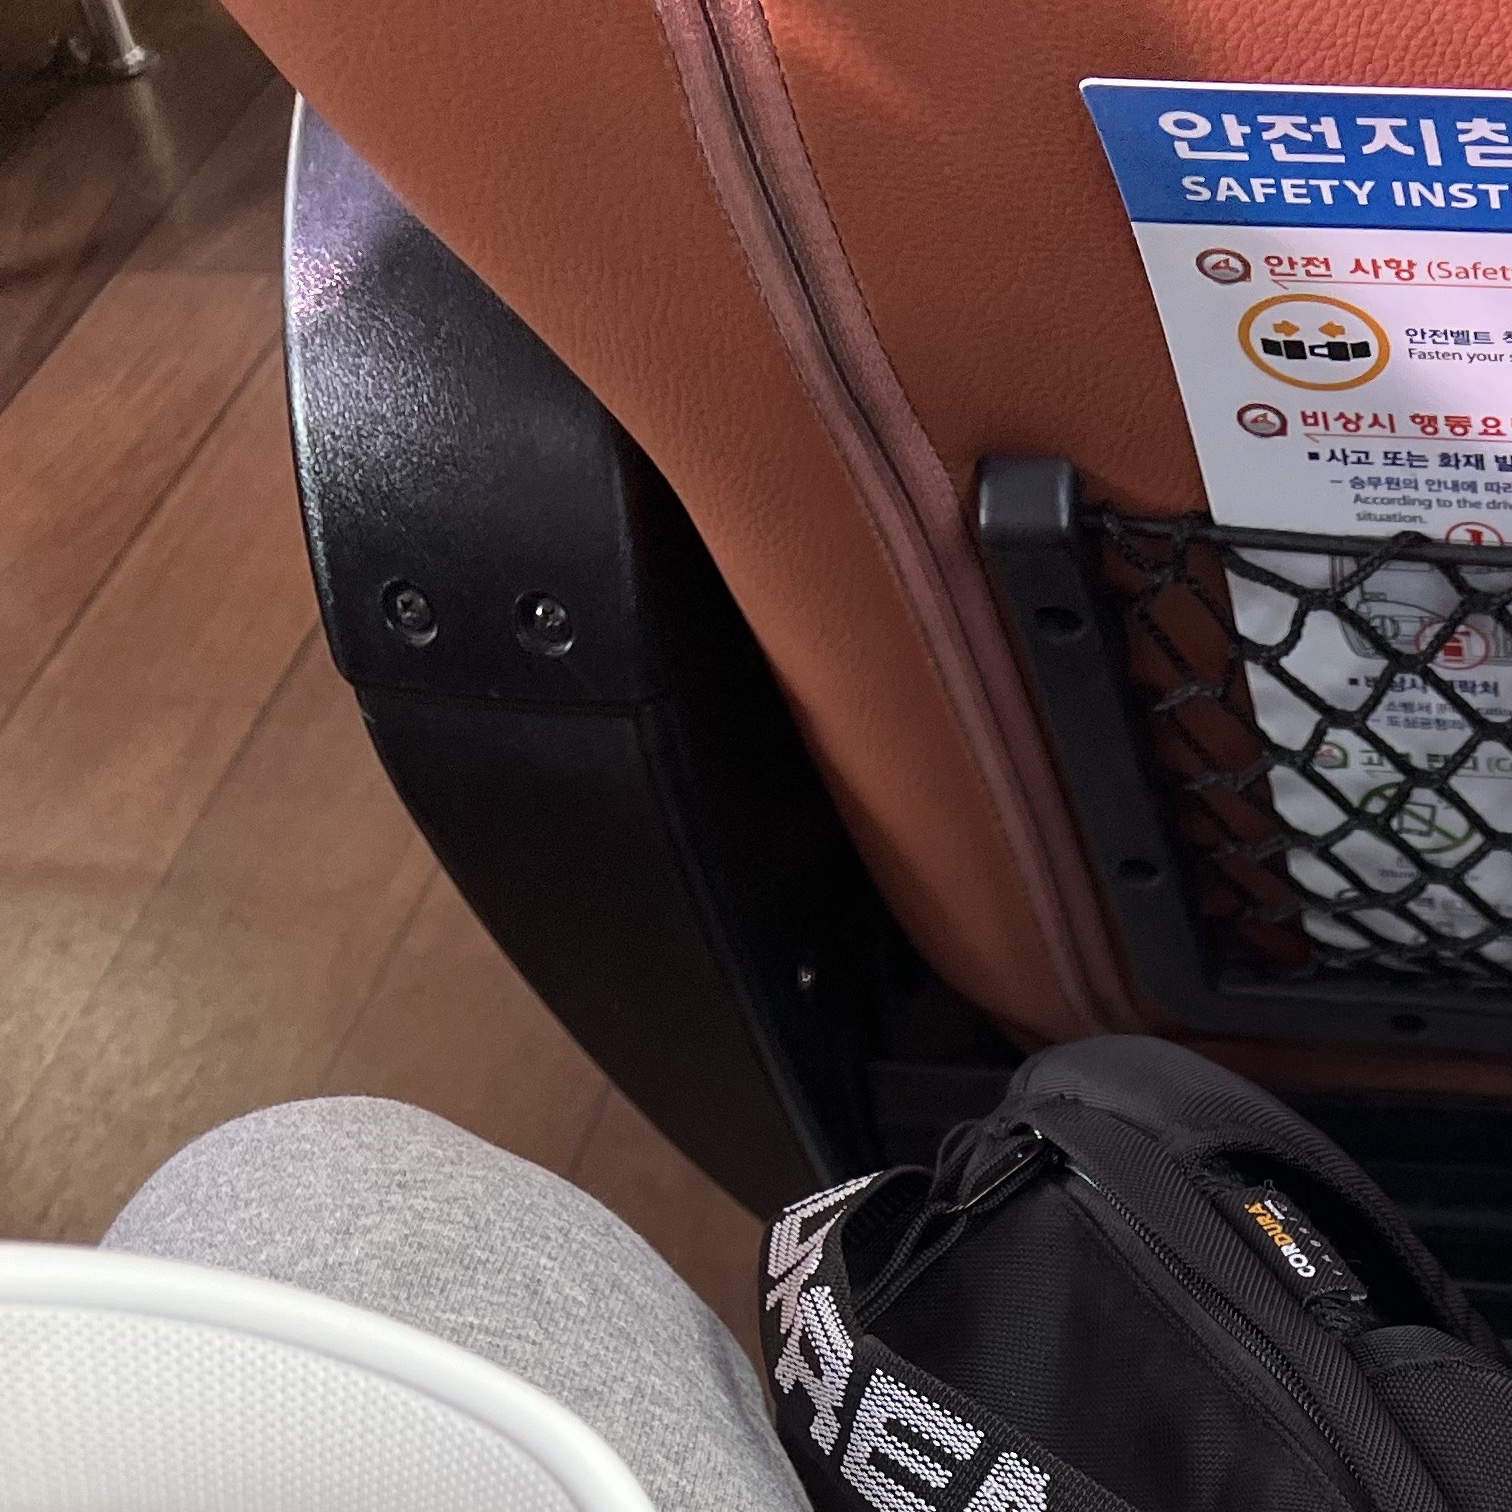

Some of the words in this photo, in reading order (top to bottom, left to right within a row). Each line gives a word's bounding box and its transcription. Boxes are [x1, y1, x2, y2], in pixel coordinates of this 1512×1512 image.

[1181, 175, 1378, 207] SAFETY
[1263, 255, 1333, 280] 안전
[1349, 257, 1415, 283] 사항
[1405, 327, 1493, 347] 안전벨트
[1408, 348, 1463, 363] Fasten
[1466, 353, 1506, 366] your
[1301, 410, 1396, 435] 비상시
[1327, 448, 1375, 466] 사고
[1383, 450, 1429, 470] 또는
[1439, 452, 1486, 472] 화재
[1353, 494, 1432, 510] According
[1437, 496, 1453, 508] to
[1457, 498, 1482, 511] the
